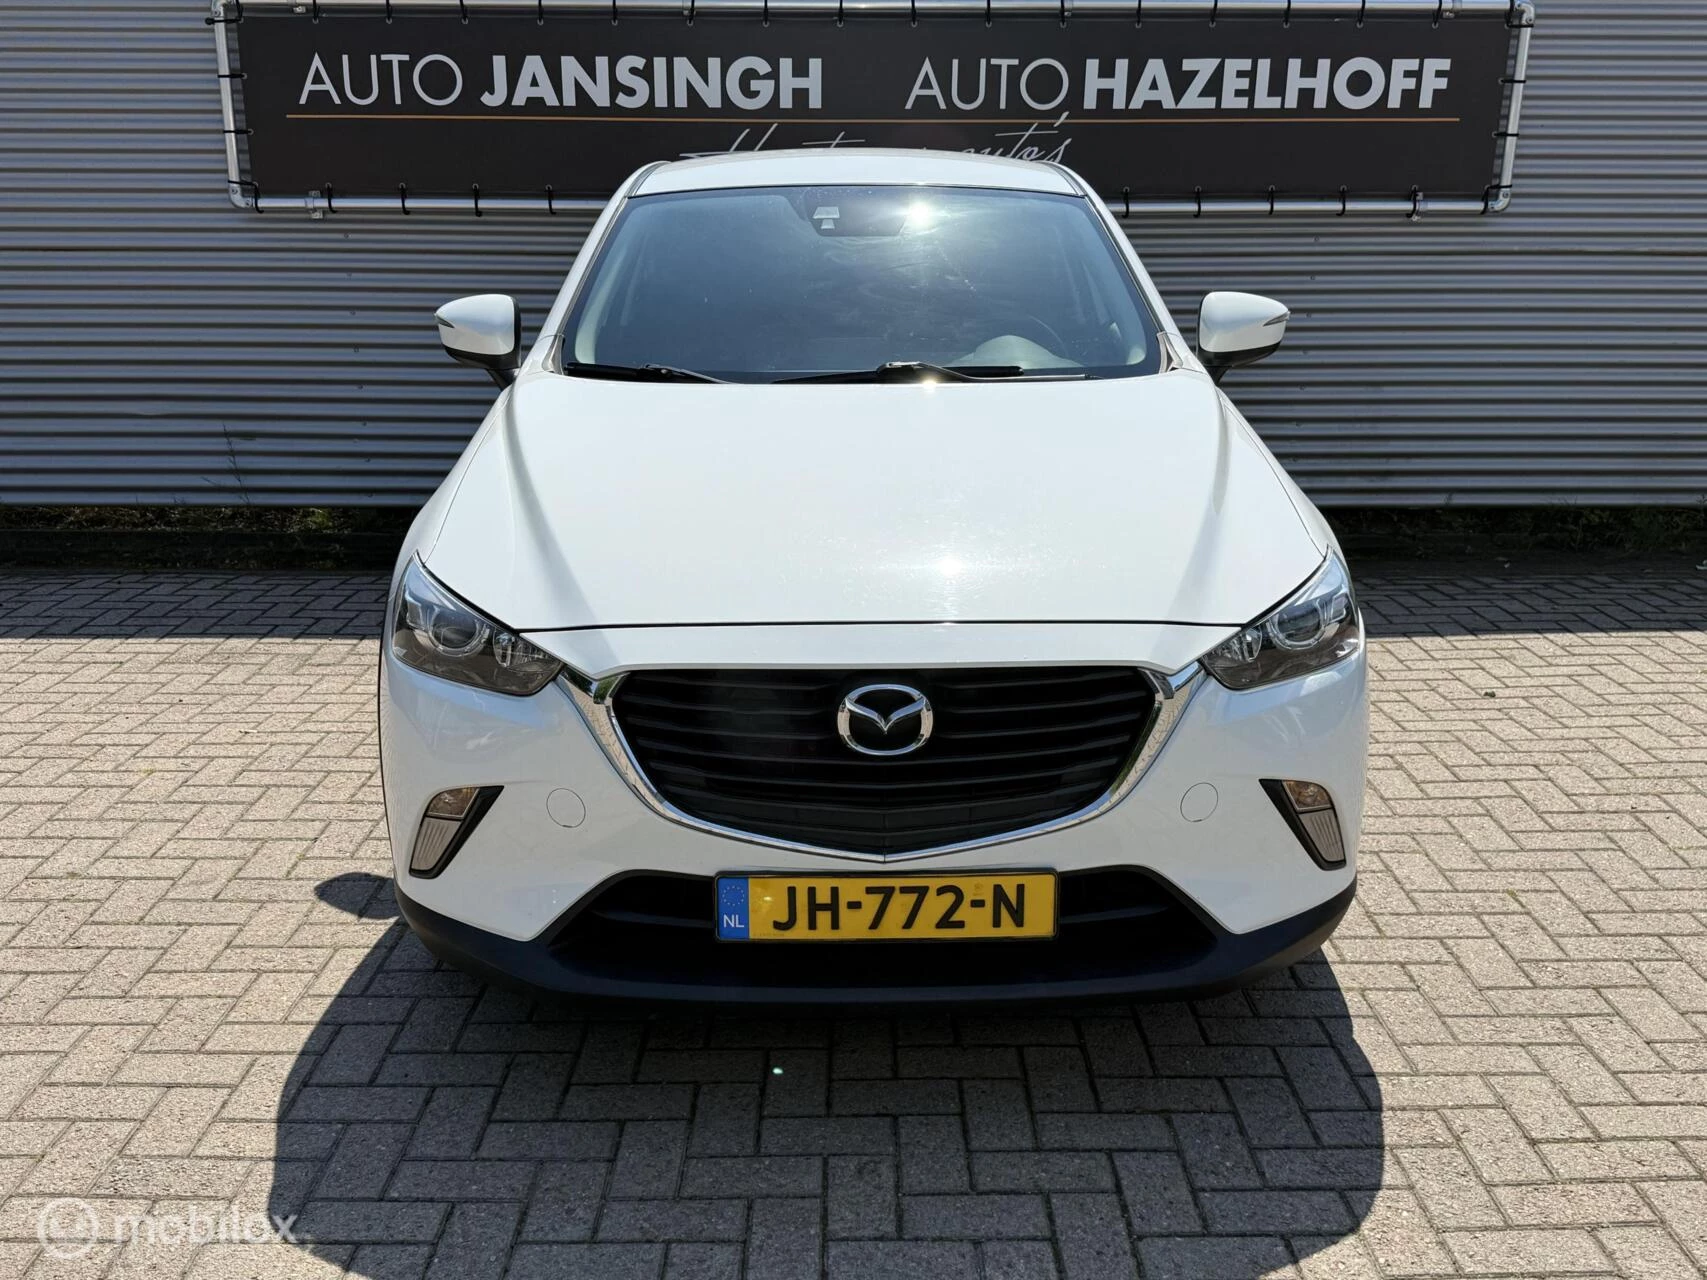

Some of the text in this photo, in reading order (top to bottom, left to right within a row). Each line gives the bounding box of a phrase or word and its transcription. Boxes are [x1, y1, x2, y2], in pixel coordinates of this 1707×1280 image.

[299, 53, 822, 110] AUTO JANSINGH
[905, 57, 1451, 111] AUTO HAZELHOFF
[723, 914, 745, 928] NL
[772, 884, 1026, 931] JH-772-N
